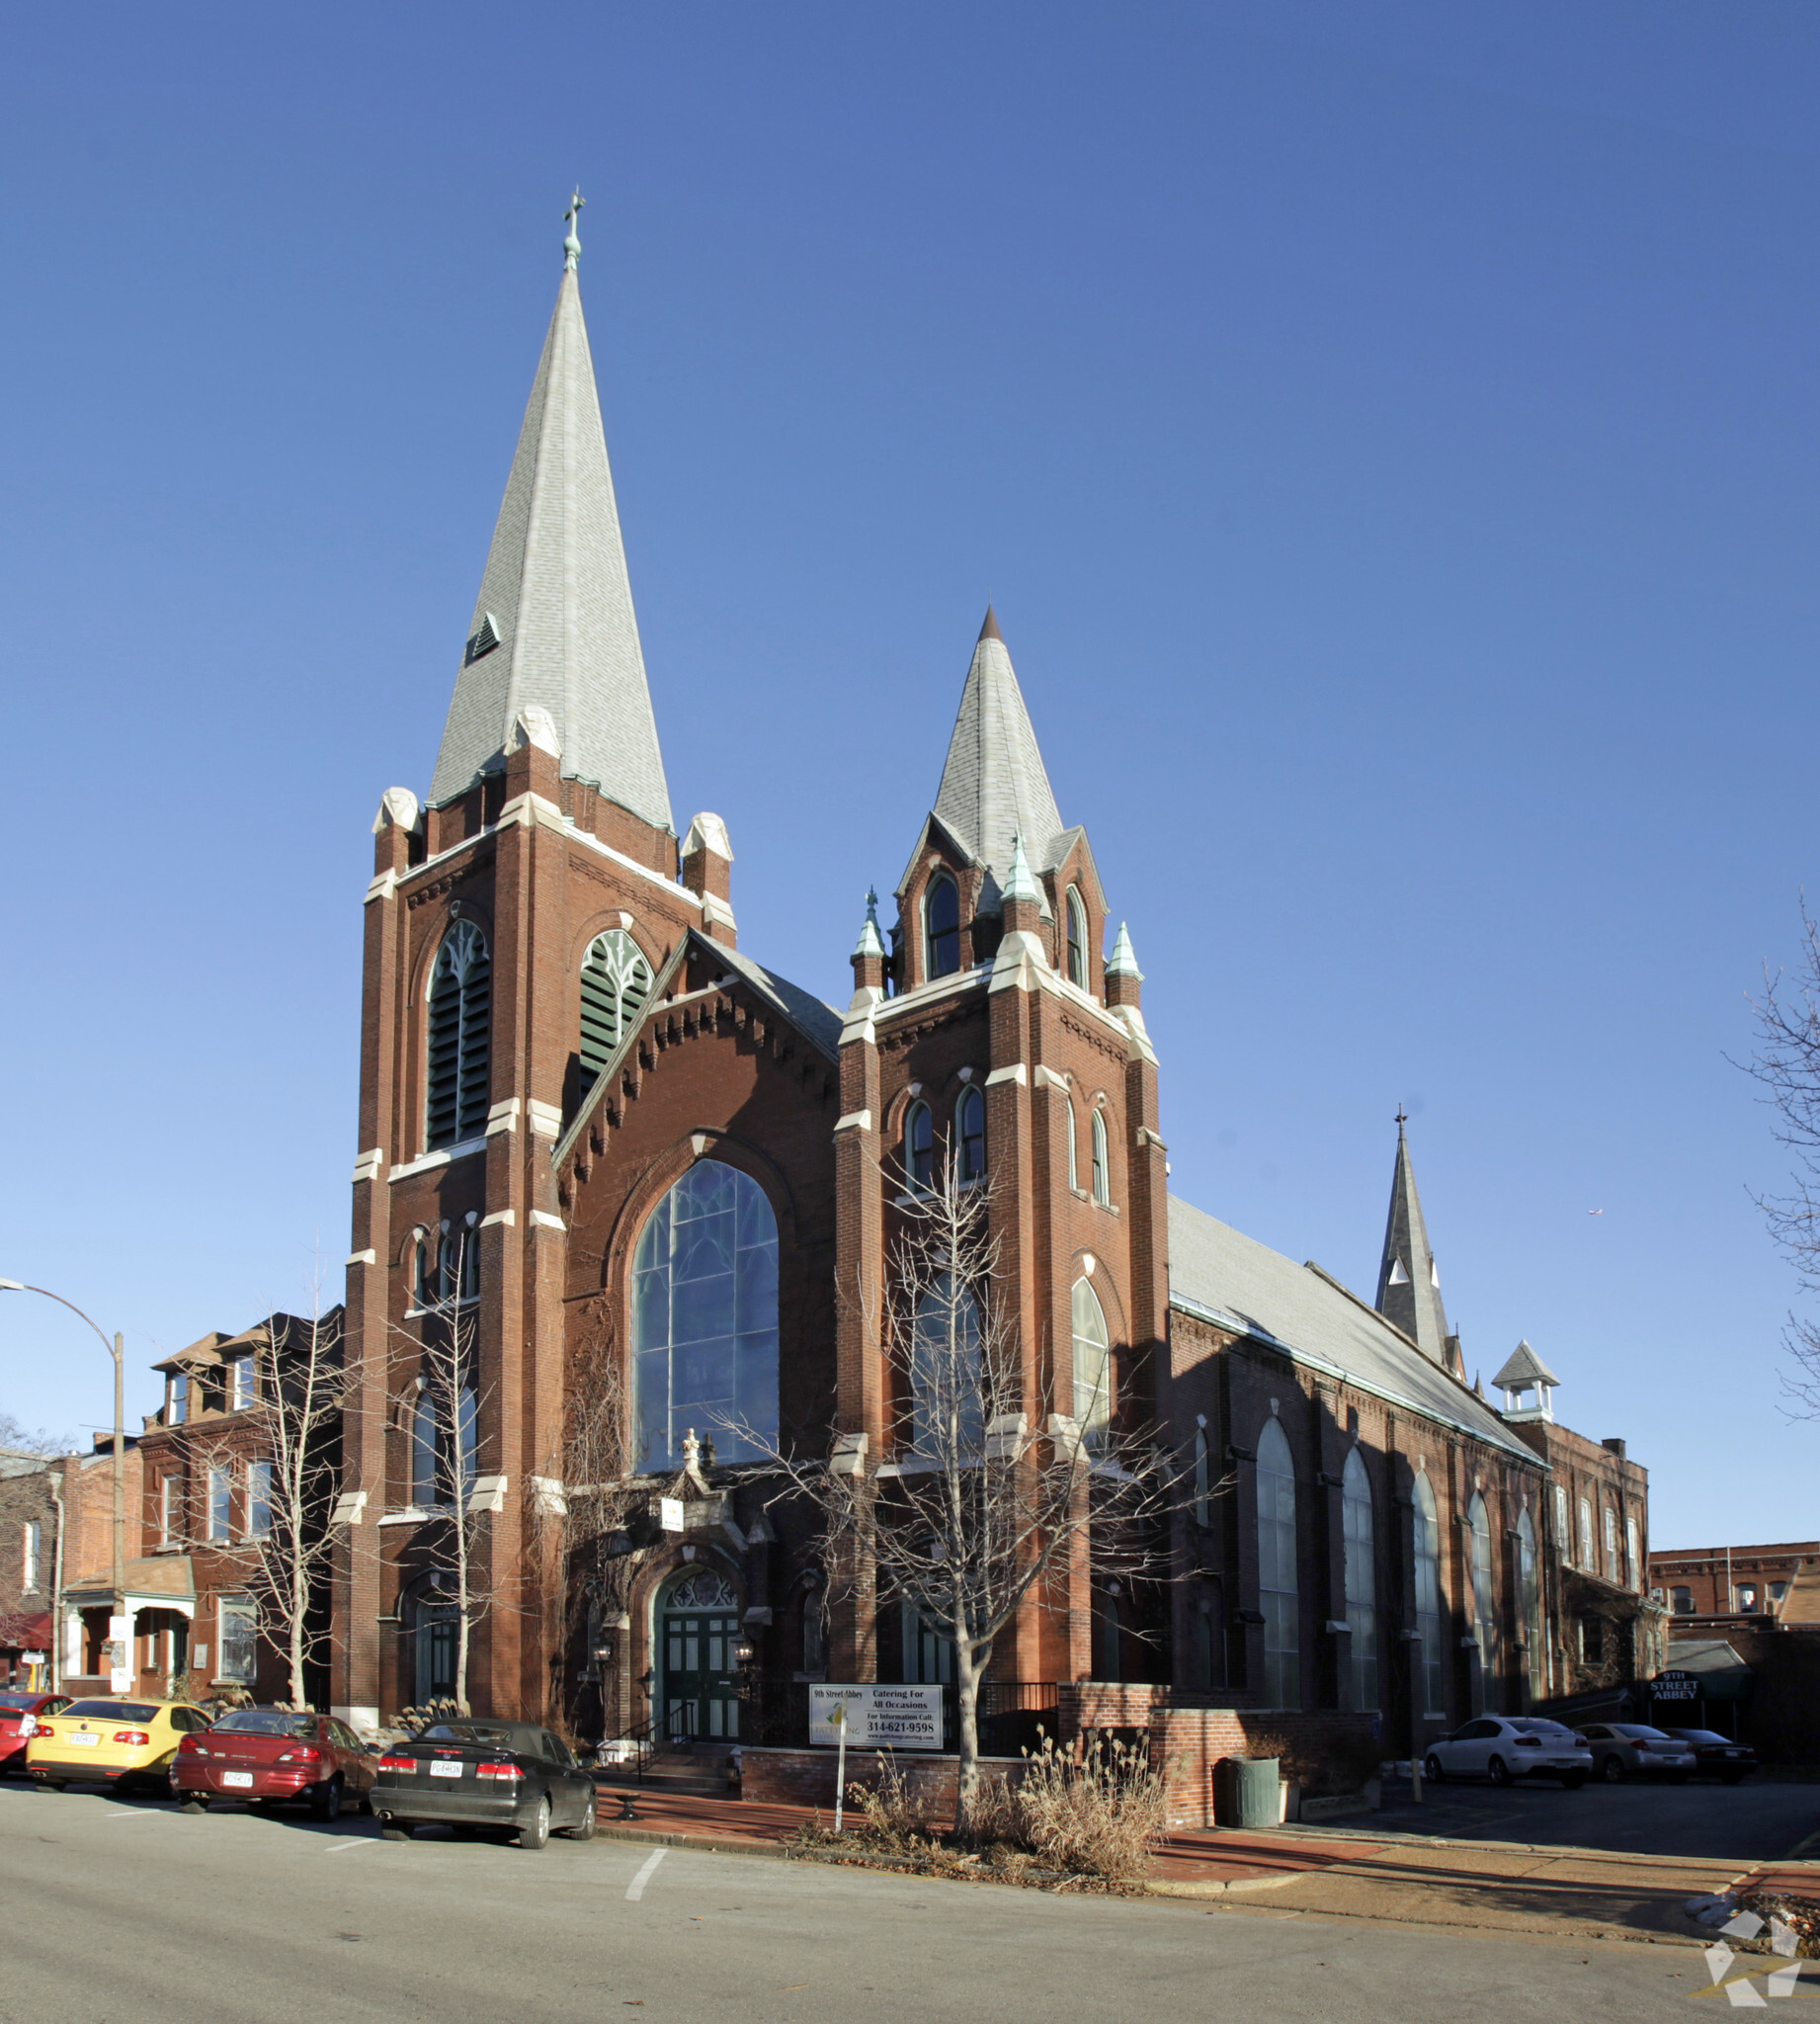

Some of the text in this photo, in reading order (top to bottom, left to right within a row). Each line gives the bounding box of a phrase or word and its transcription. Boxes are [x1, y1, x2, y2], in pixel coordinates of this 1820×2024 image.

[1663, 1671, 1685, 1680] 9TH
[1650, 1681, 1698, 1690] STREET
[814, 1689, 825, 1699] 9th
[826, 1689, 843, 1699] Street
[872, 1689, 908, 1700] Catering
[1653, 1690, 1696, 1699] ABBEY
[872, 1700, 928, 1709] All Occasions
[867, 1721, 935, 1733] 314-621-9598
